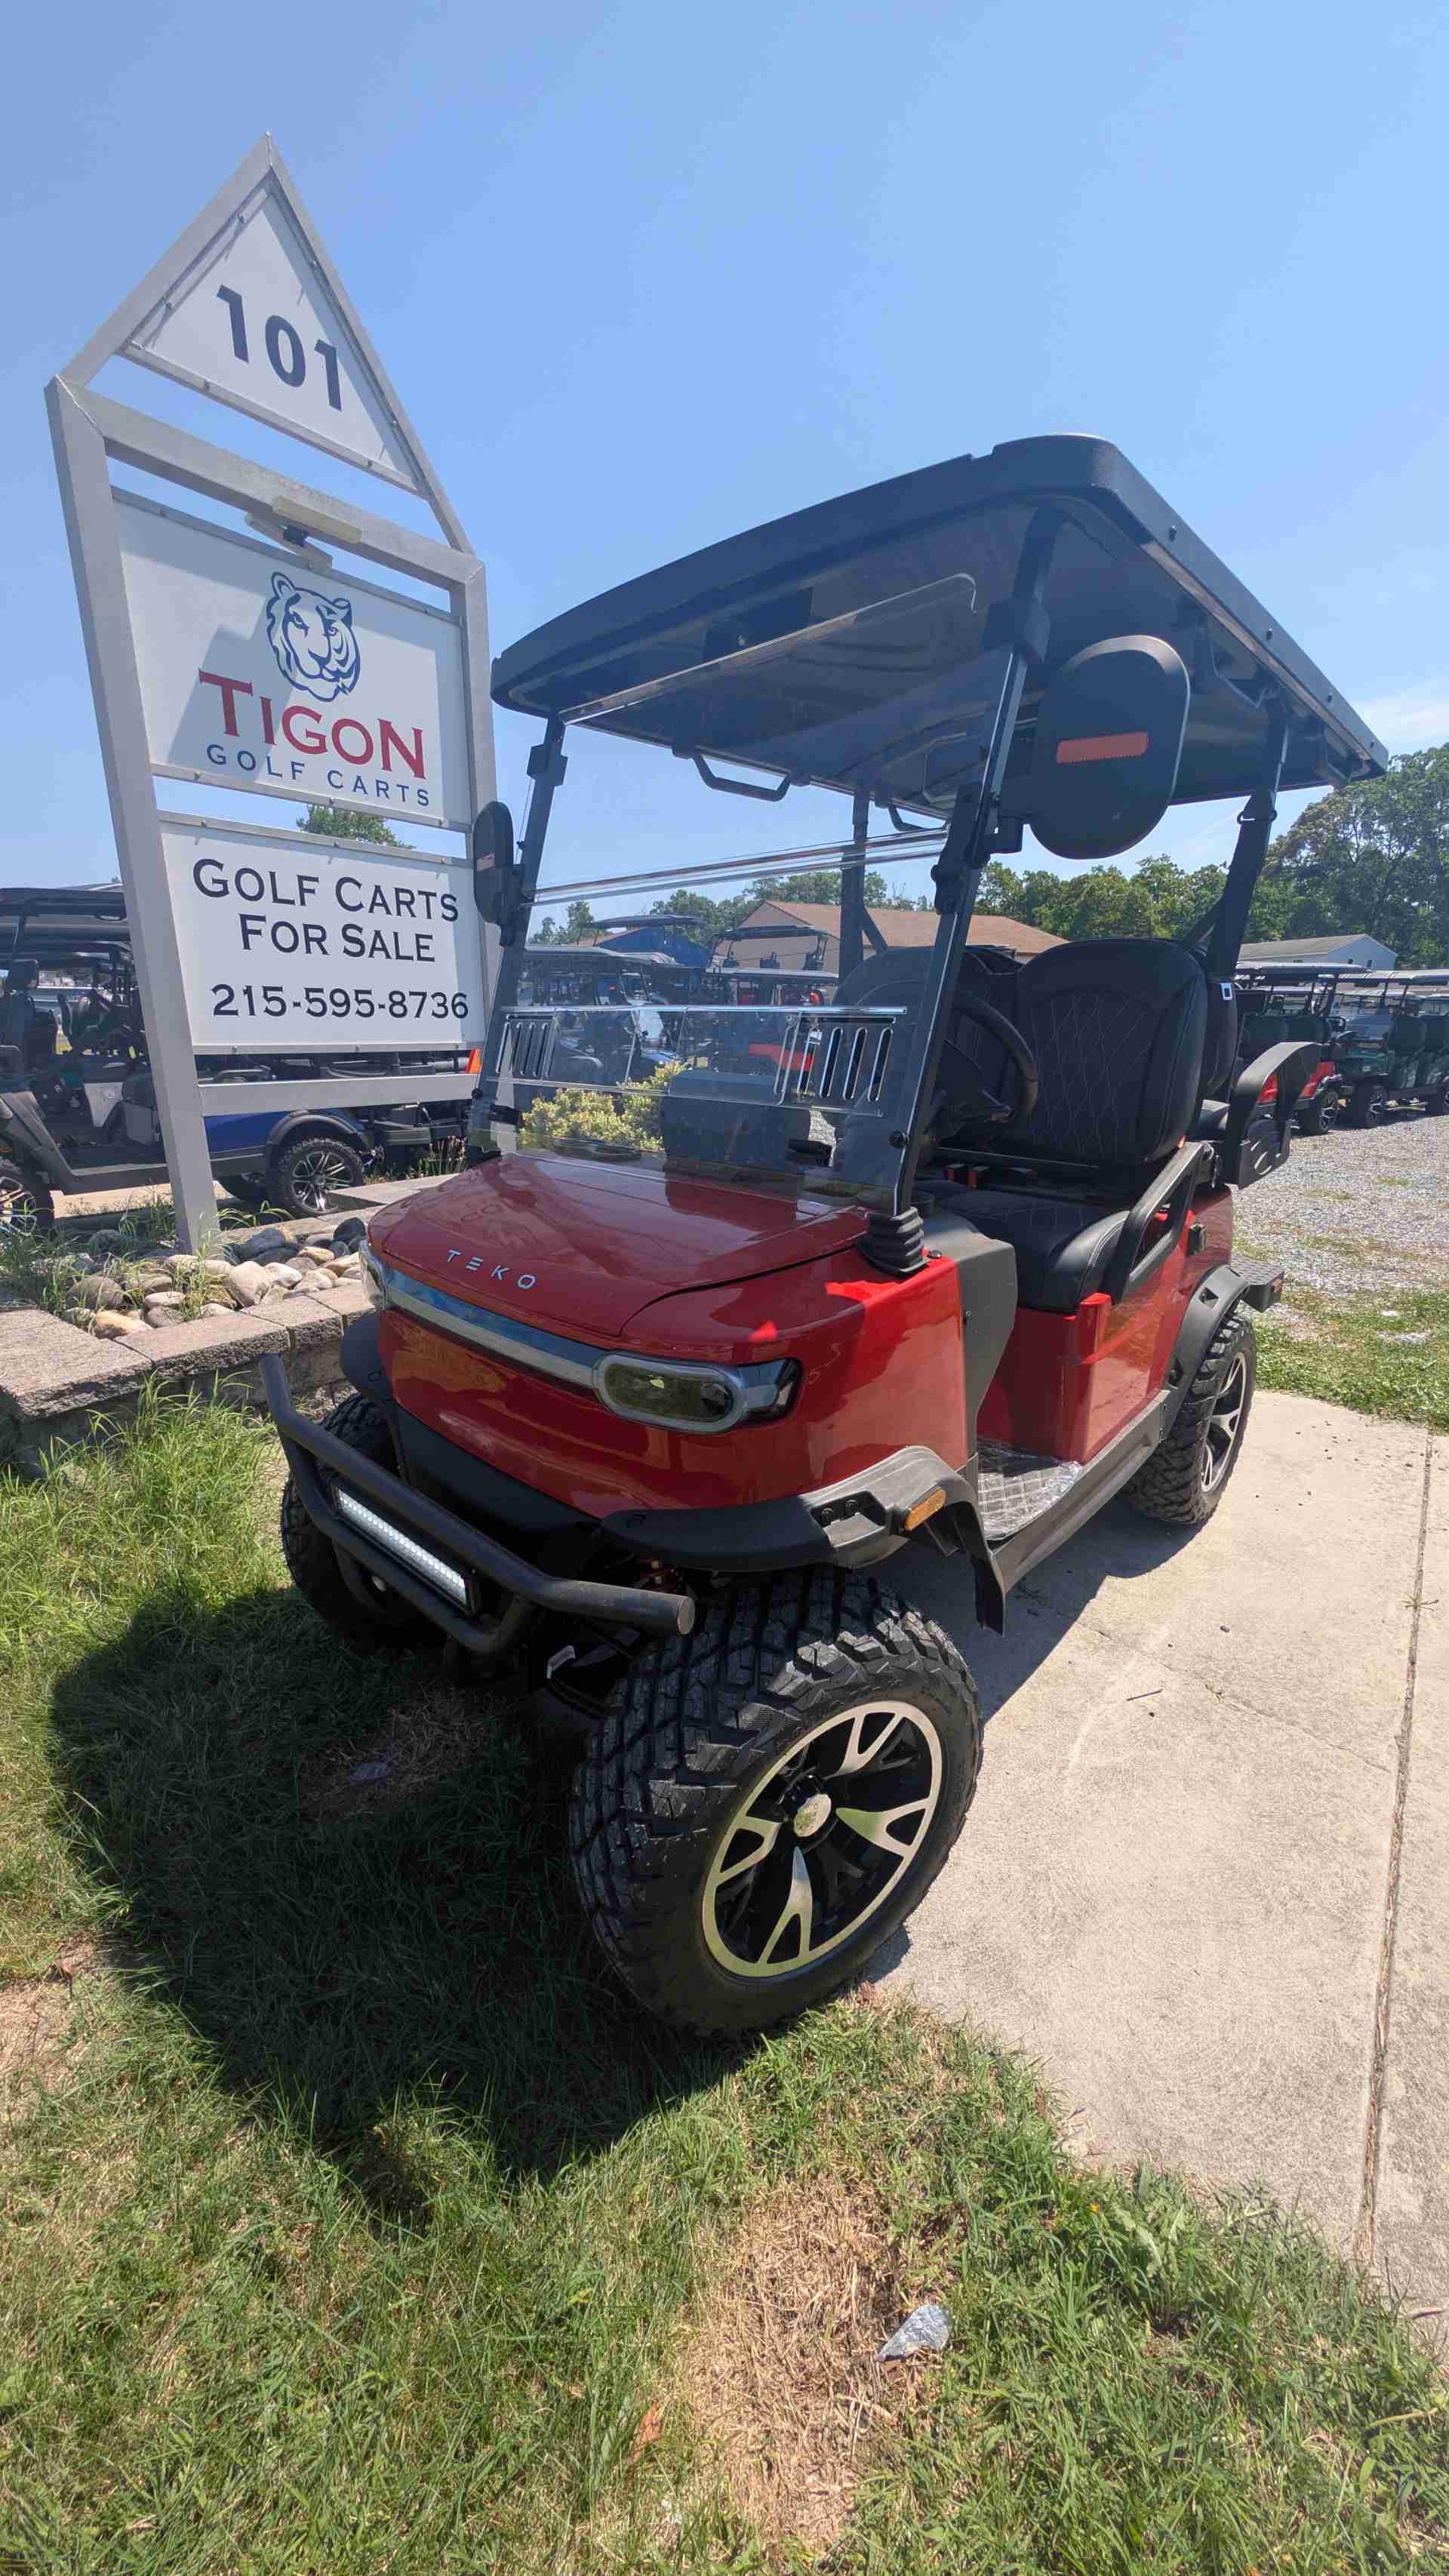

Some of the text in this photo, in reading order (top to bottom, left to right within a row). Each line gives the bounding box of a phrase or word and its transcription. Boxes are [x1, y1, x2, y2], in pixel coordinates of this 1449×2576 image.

[217, 284, 343, 411] 101
[198, 668, 426, 780] TIGON
[206, 743, 430, 807] GOLF CARTS
[192, 858, 459, 922] GOLF CARTS
[238, 913, 435, 962] FOR SALE
[211, 983, 469, 1020] 215-595-8736
[447, 1249, 537, 1290] TEKO
